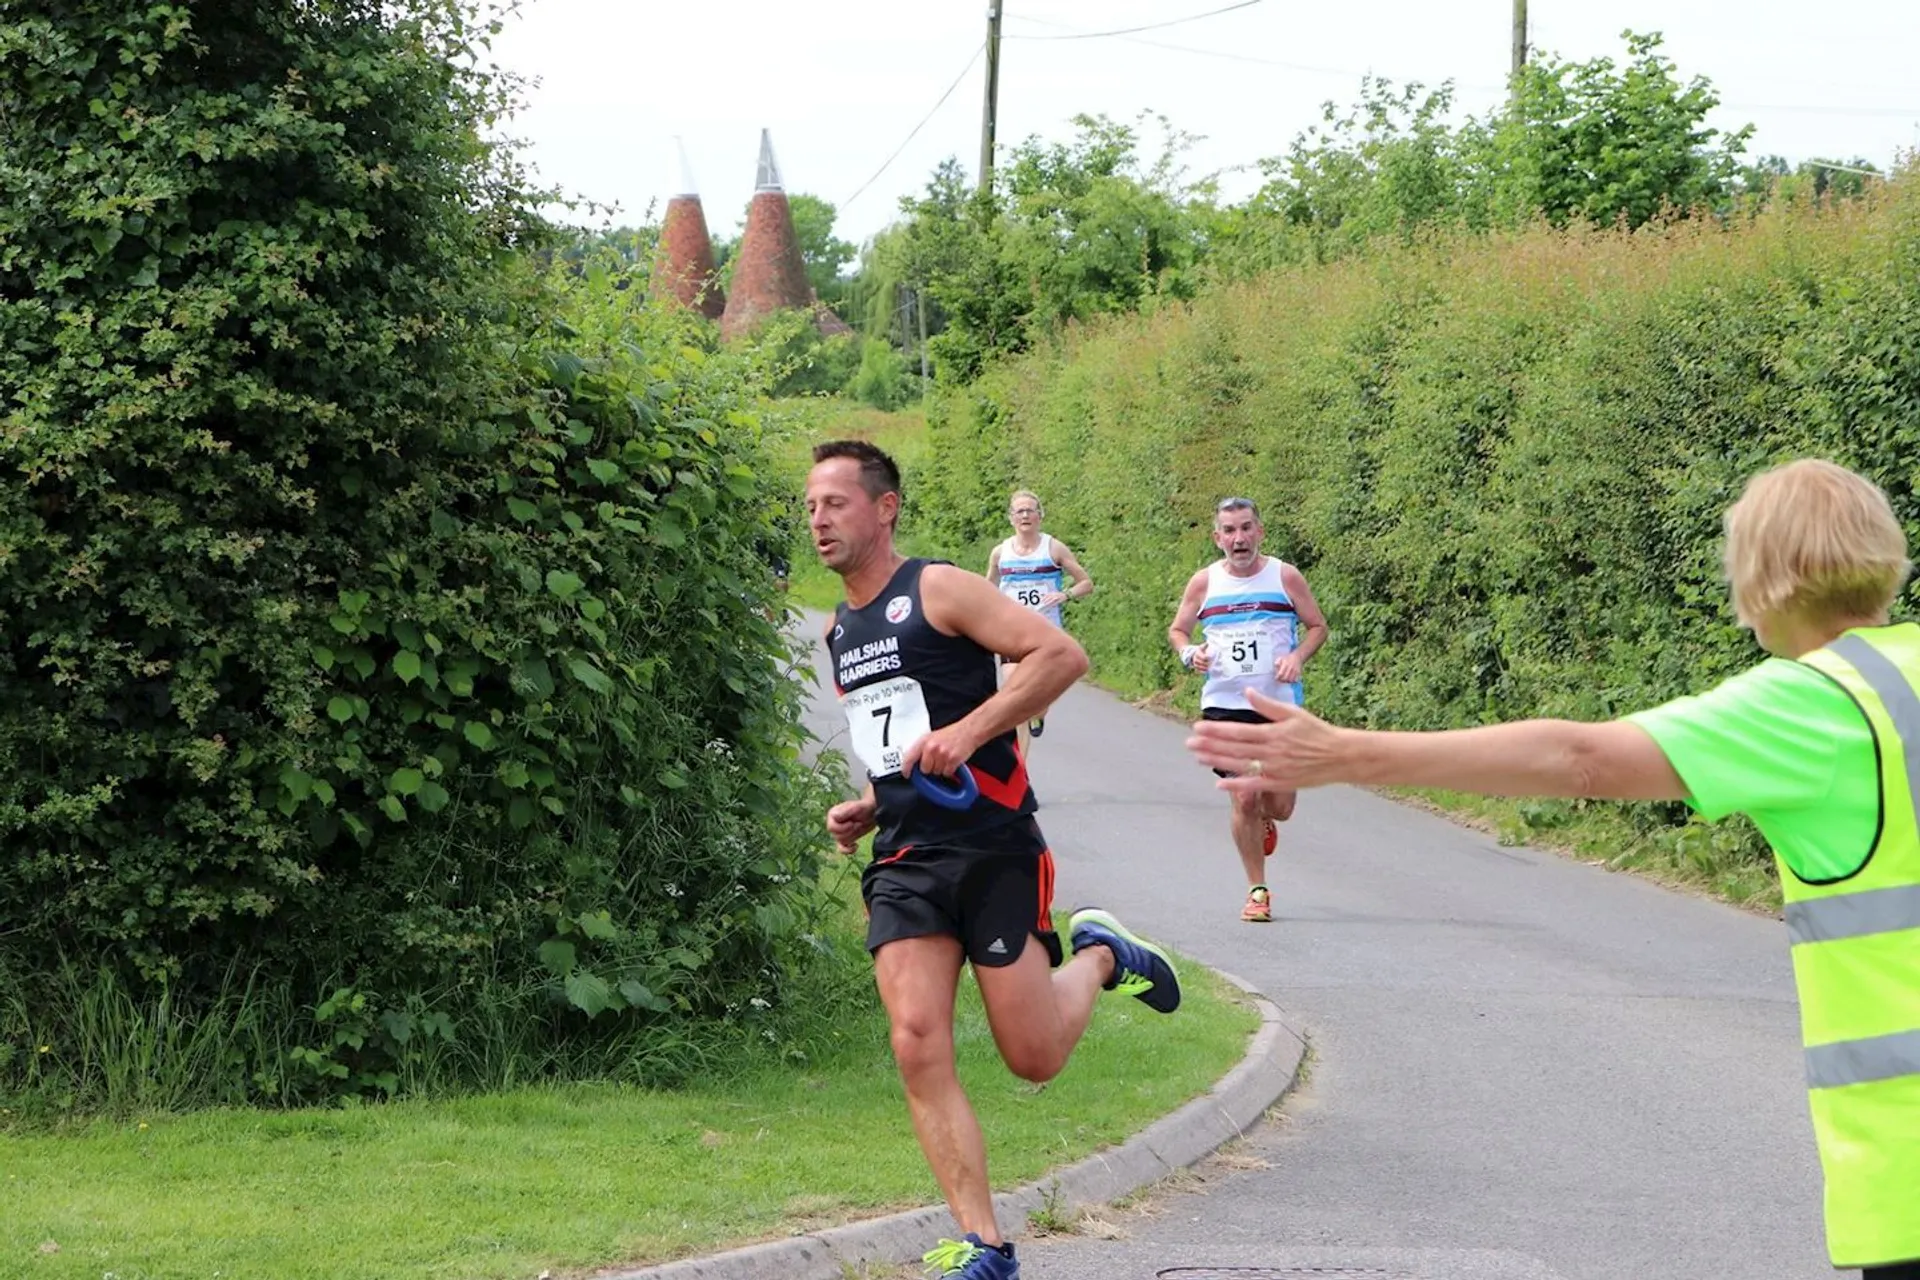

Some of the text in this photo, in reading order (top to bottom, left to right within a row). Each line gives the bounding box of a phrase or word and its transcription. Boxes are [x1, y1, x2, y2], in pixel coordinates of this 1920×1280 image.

[1018, 589, 1040, 606] 56
[839, 636, 899, 668] HAILSHAM
[1232, 640, 1258, 662] 51
[839, 654, 901, 685] HARRIERS
[872, 706, 892, 747] 7
